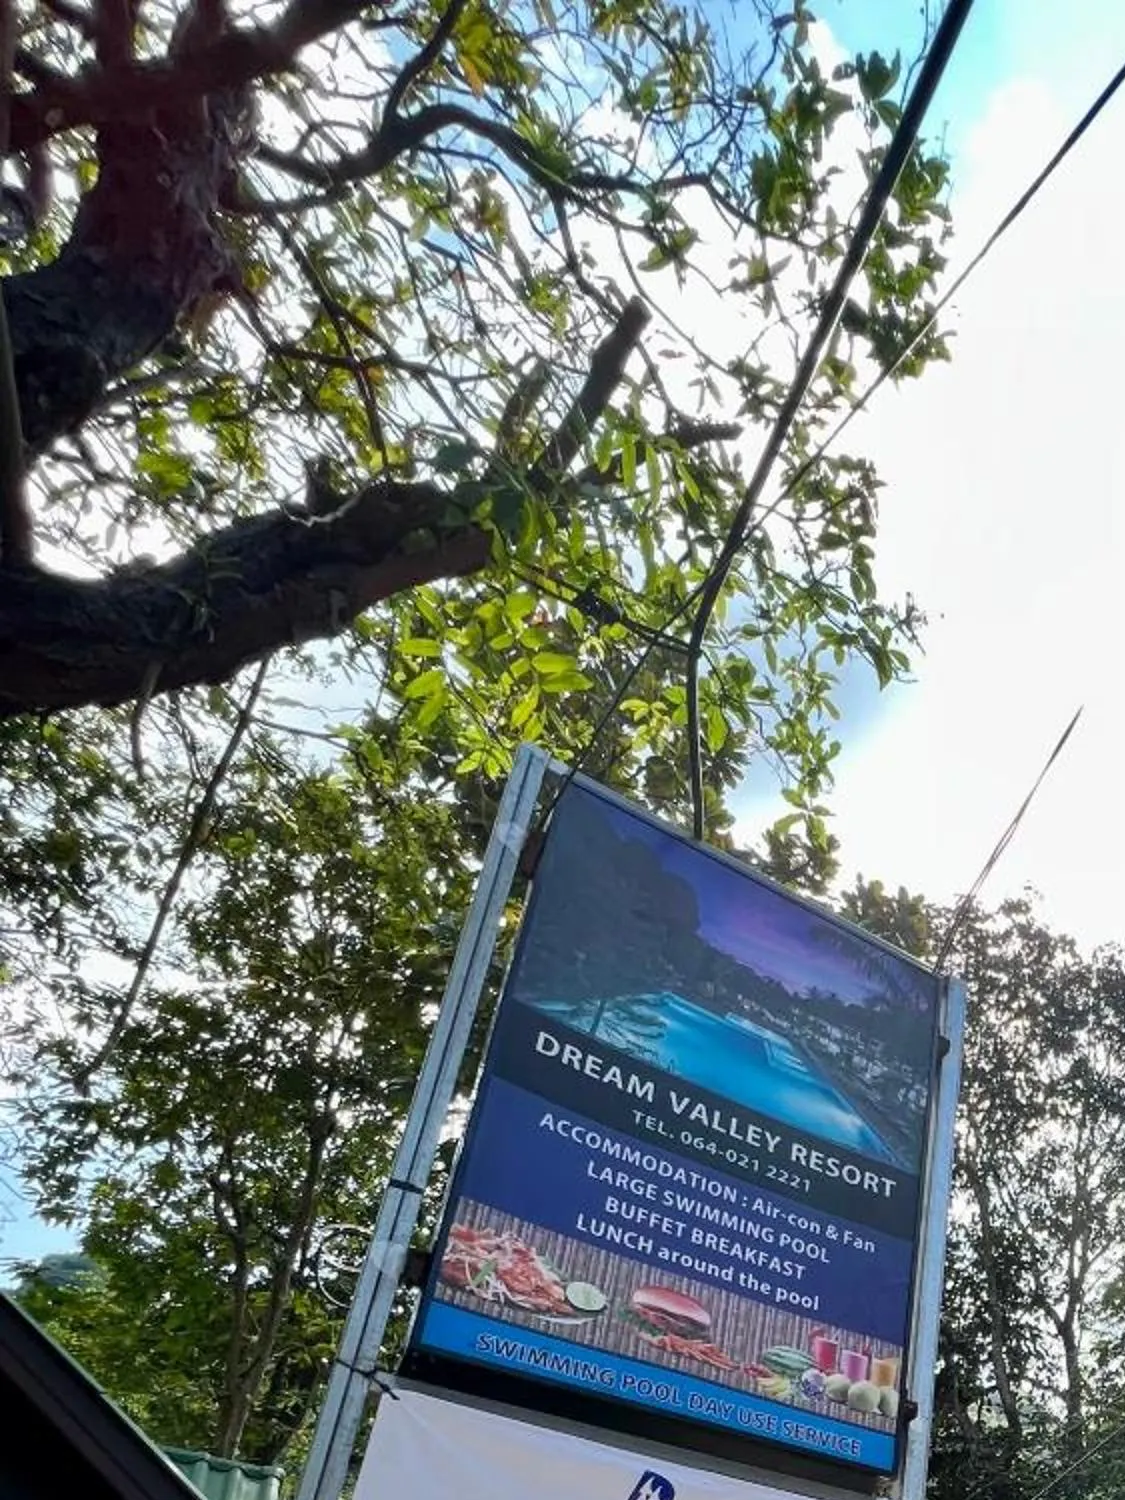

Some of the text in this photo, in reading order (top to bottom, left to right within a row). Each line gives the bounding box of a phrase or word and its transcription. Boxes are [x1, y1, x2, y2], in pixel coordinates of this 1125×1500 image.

[535, 1031, 897, 1197] DREAM VALLEY RESORT
[632, 1110, 811, 1192] TEL. 064-021 2221
[539, 1113, 737, 1204] ACCOMMODATION
[751, 1197, 821, 1235] Air-con
[825, 1224, 840, 1241] &
[843, 1231, 876, 1253] Fan
[587, 1161, 831, 1263] LARGE SWIMMING POOL
[576, 1213, 820, 1311] LUNCH around the pool
[605, 1196, 806, 1280] BUFFET BREAKFAST
[476, 1332, 863, 1457] SWIMMING POOL DAY USE SERVICE
